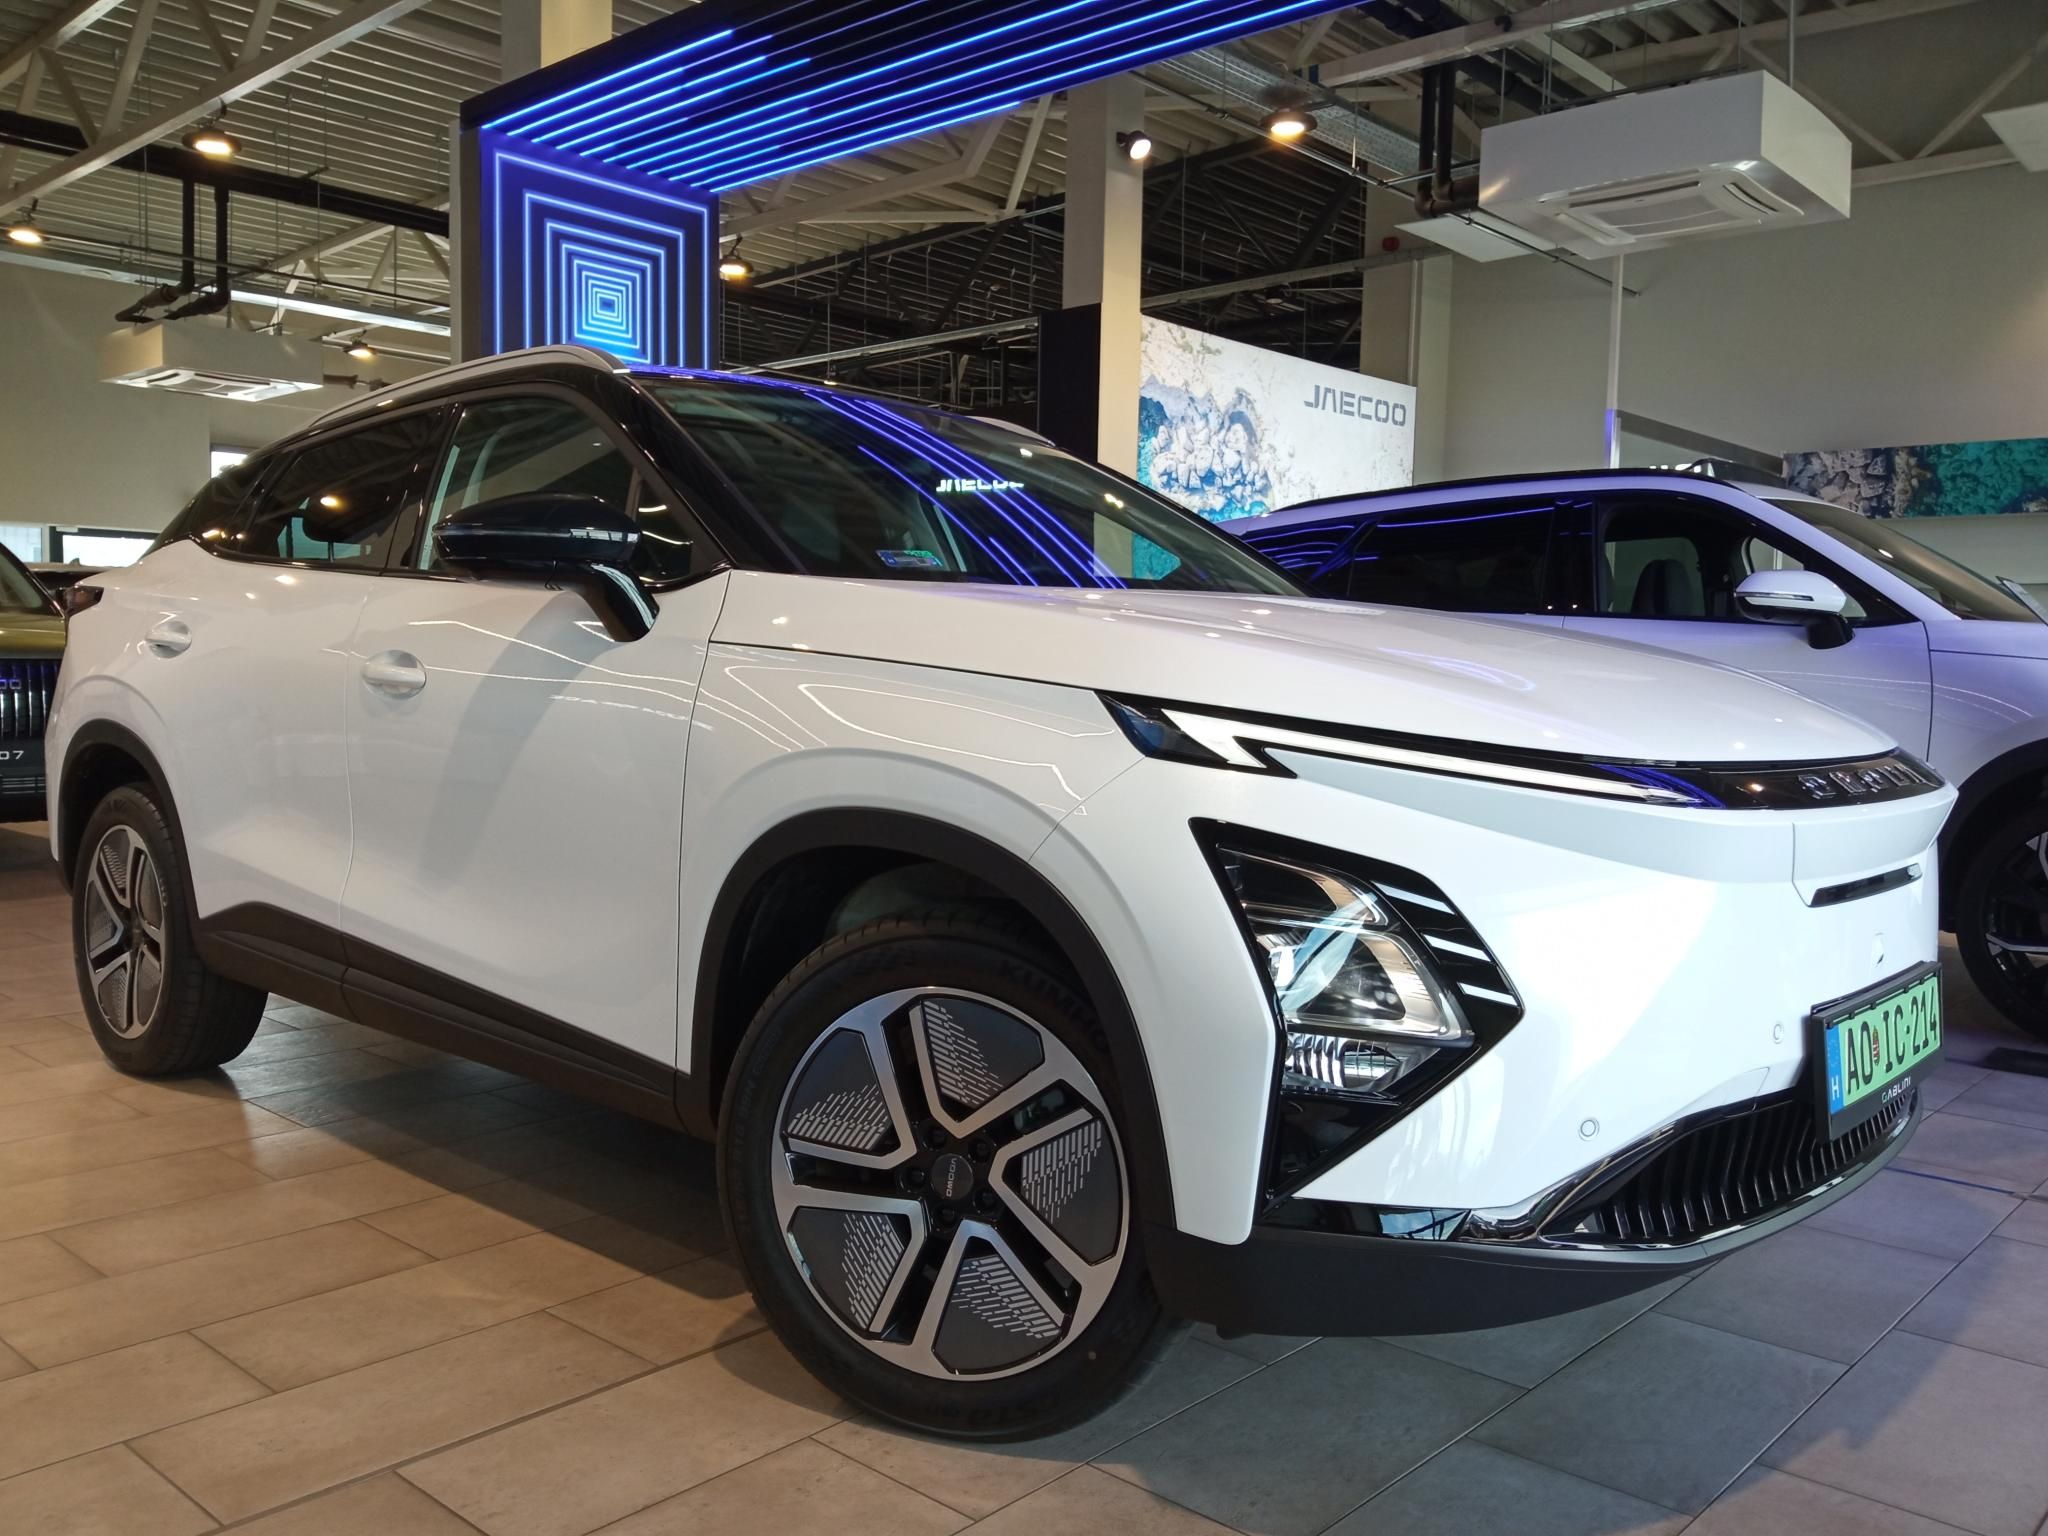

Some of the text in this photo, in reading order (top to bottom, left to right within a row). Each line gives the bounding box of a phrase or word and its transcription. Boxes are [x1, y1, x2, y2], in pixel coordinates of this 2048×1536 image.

[1303, 384, 1407, 427] JAECOO
[1846, 1020, 1874, 1096] AO
[1831, 1075, 1840, 1100] H
